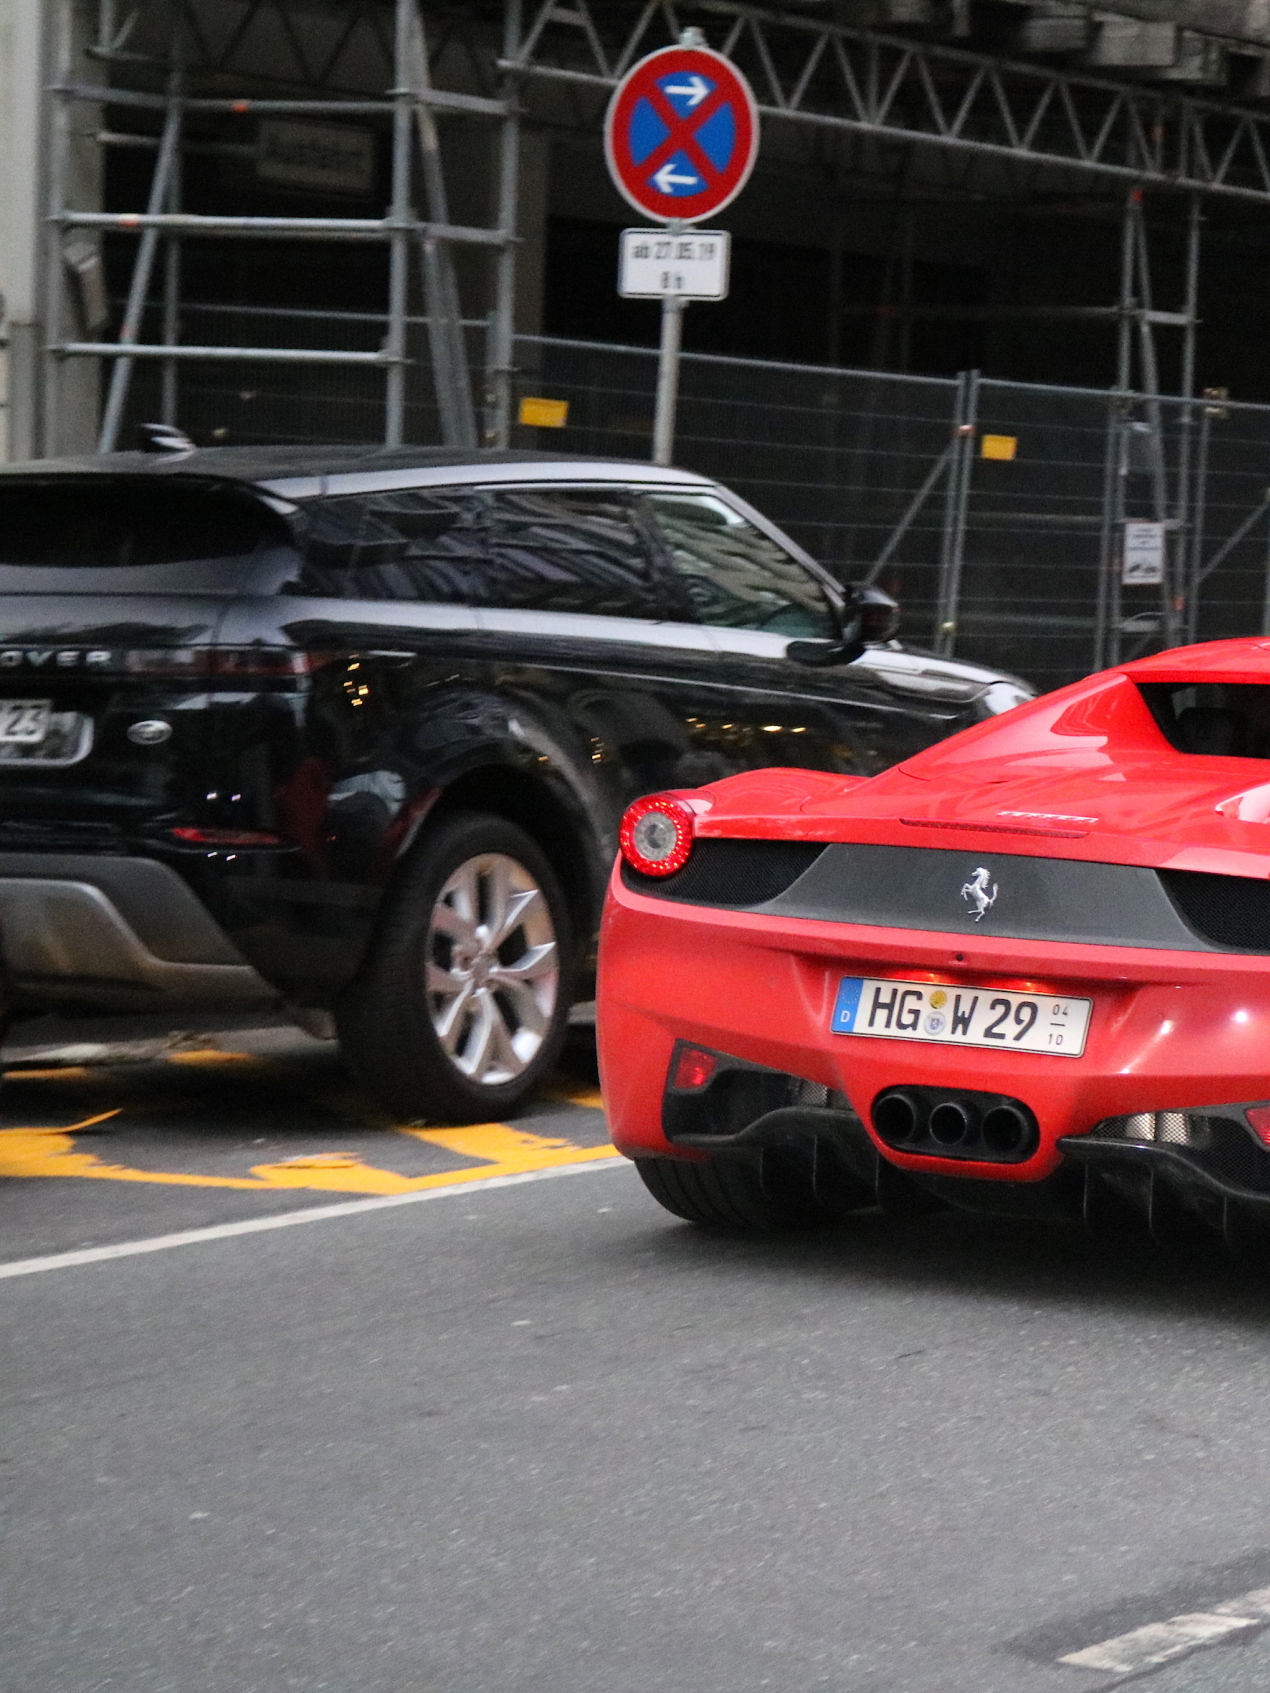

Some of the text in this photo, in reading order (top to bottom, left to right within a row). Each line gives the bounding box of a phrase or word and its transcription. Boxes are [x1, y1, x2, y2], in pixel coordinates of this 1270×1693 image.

[840, 1010, 850, 1023] D
[868, 987, 1039, 1042] HG W 29
[1052, 1004, 1069, 1016] 04
[1048, 1033, 1064, 1046] 10
